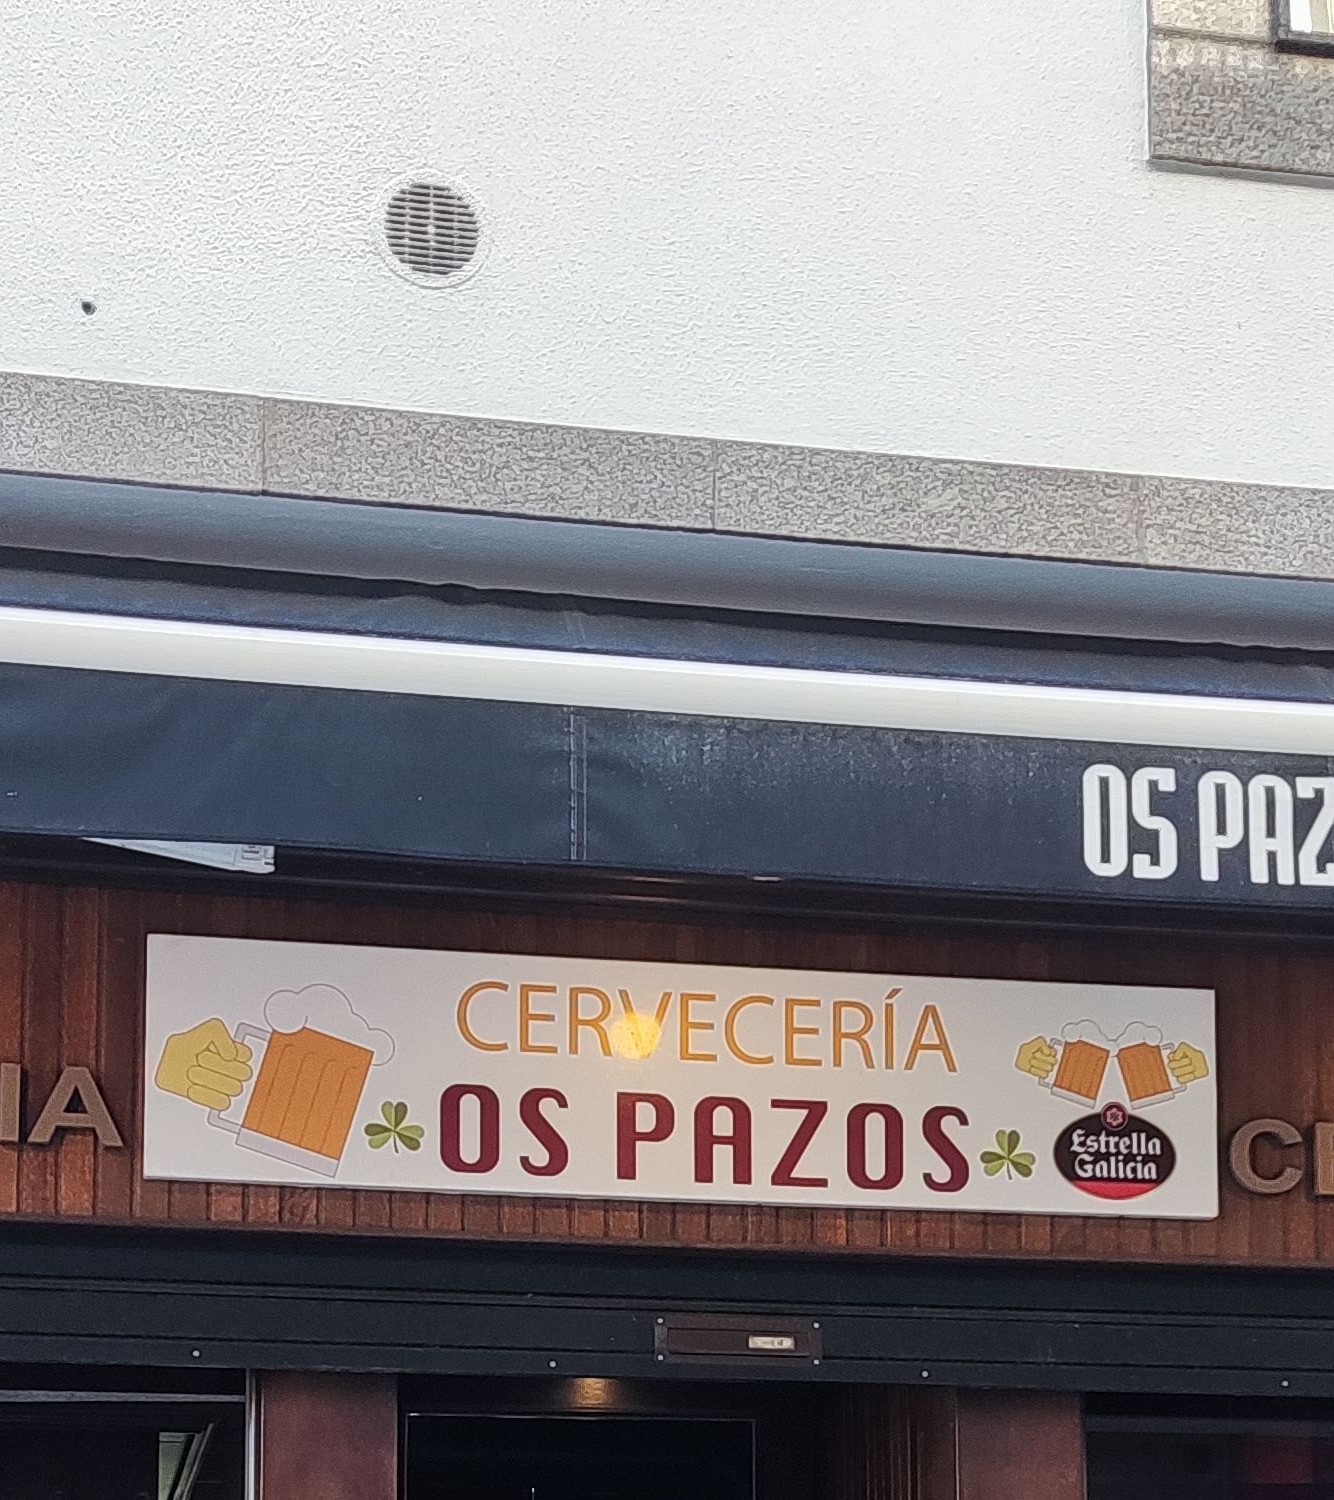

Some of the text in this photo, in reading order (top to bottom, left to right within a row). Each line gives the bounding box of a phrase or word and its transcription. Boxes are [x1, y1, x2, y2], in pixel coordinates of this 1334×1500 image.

[1081, 763, 1179, 881] OS
[457, 979, 959, 1074] CERVECERÍA
[439, 1083, 971, 1193] OS PAZOS
[1069, 1128, 1162, 1155] Estrella
[1074, 1153, 1158, 1180] Galicia
